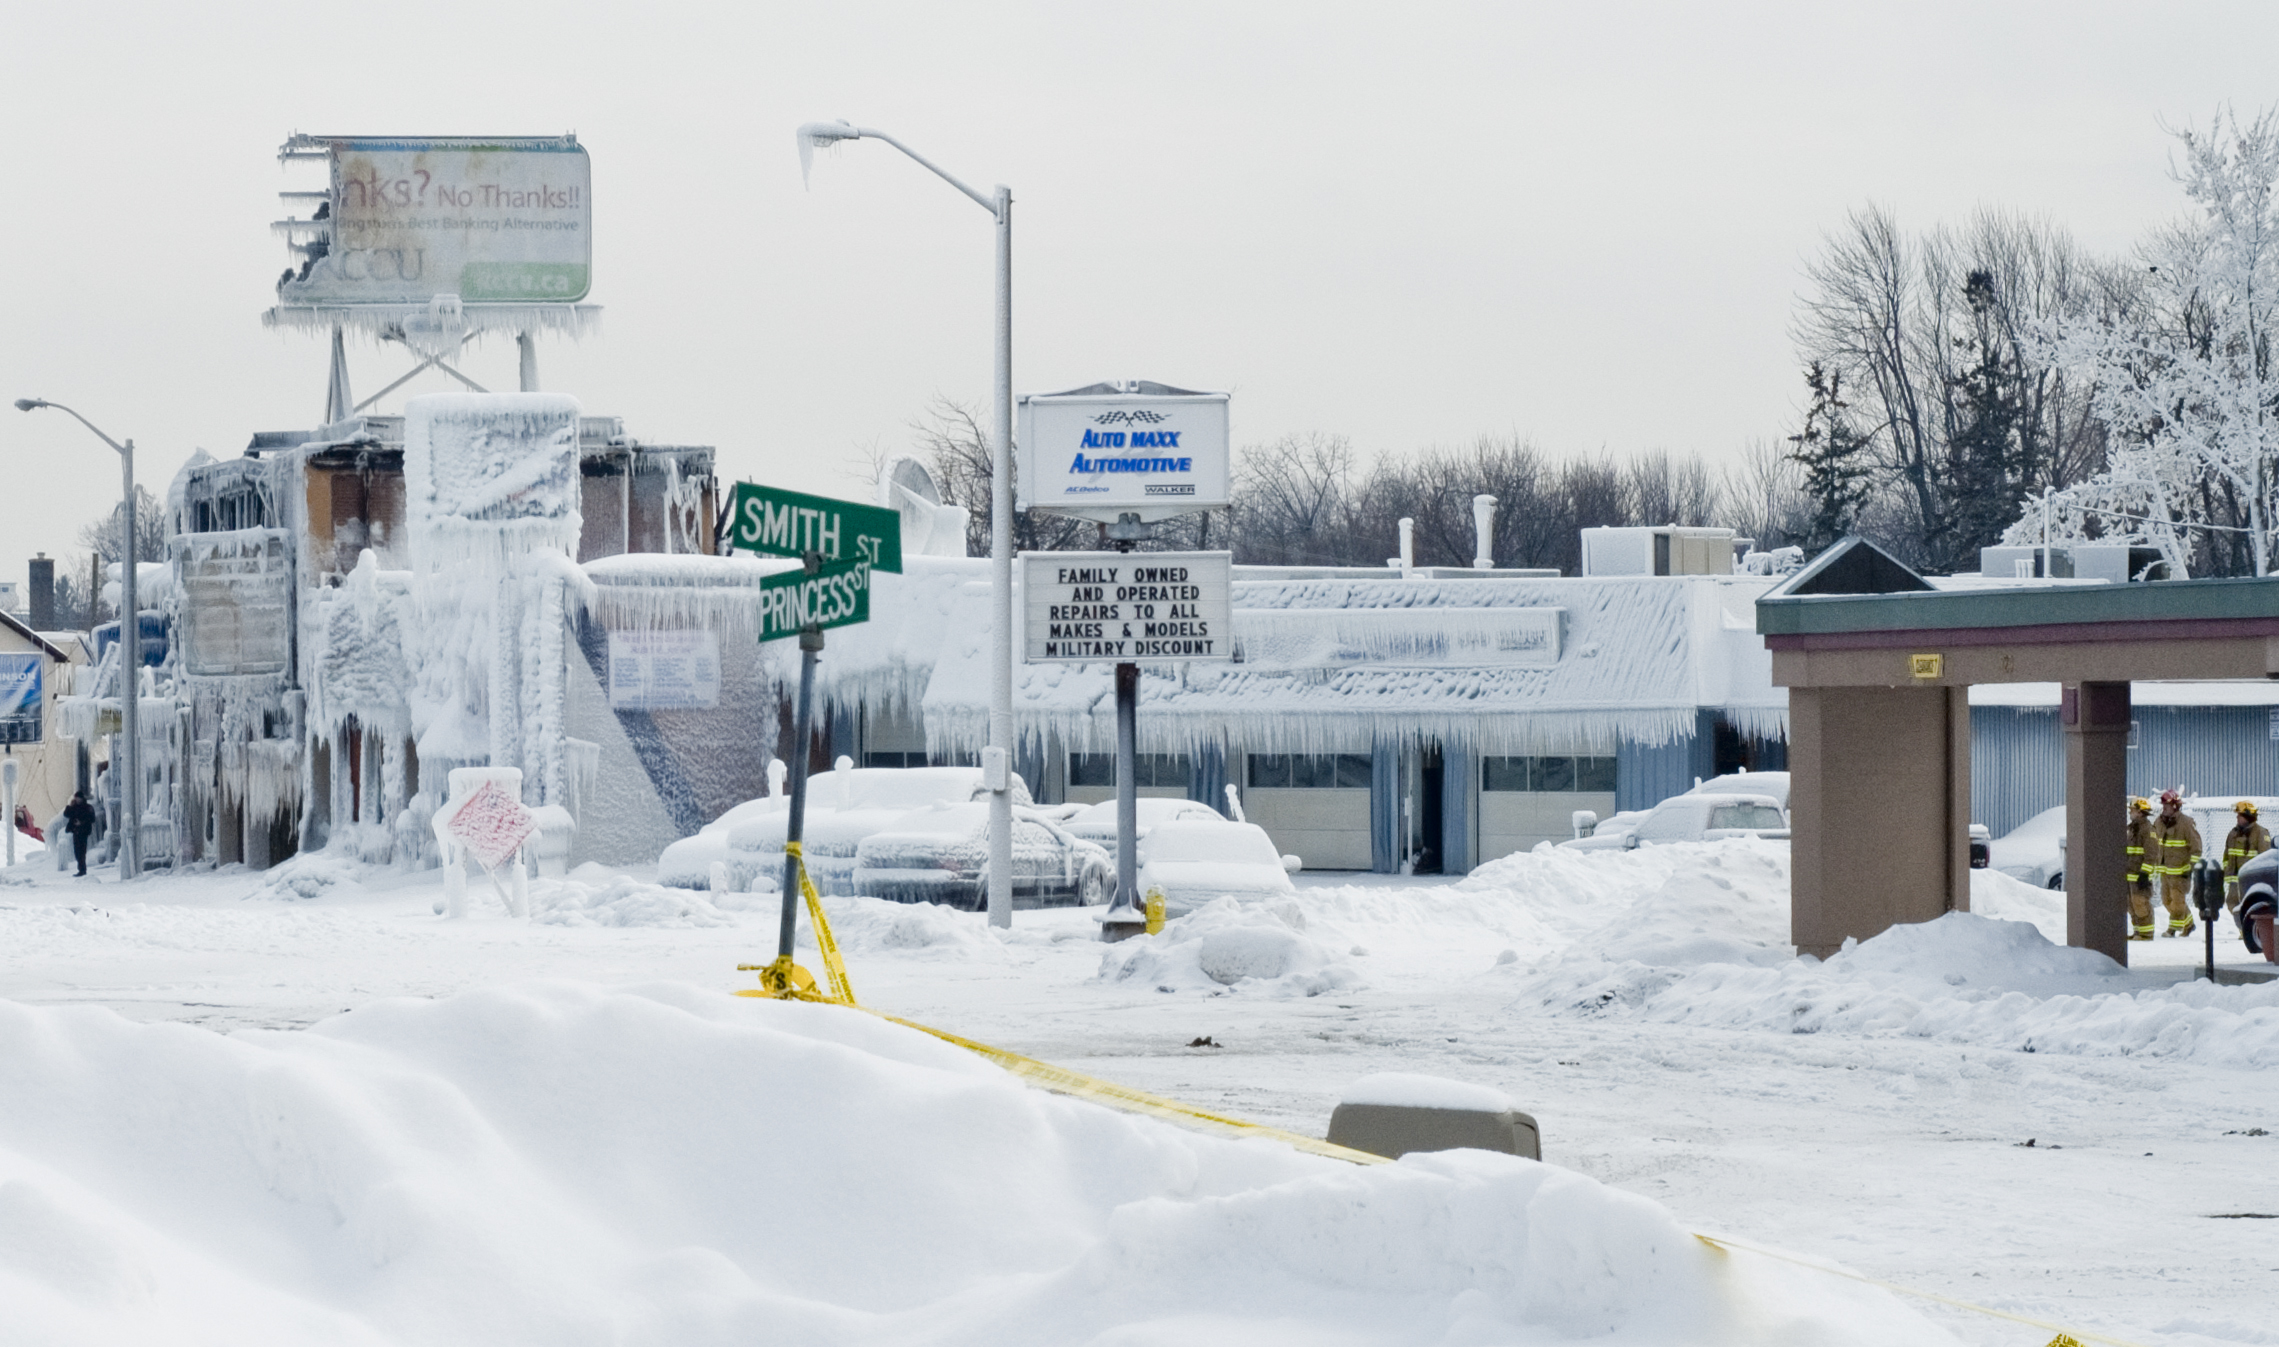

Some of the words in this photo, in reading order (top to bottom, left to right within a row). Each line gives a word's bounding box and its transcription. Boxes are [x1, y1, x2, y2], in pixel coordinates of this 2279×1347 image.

[438, 185, 473, 208] No
[479, 184, 579, 209] Thanks!!
[443, 217, 499, 232] Banking
[503, 217, 579, 231] Alternative
[1130, 430, 1182, 449] MAXX
[1145, 485, 1195, 494] WALKER
[740, 496, 841, 560] SMITH
[855, 533, 882, 564] ST
[1058, 568, 1118, 583] FAMILY
[1134, 567, 1188, 582] OWNED
[759, 570, 857, 634] PRINCESS
[854, 562, 870, 591] ST
[1072, 587, 1104, 601] AND
[1116, 586, 1200, 600] OPERATED
[1050, 605, 1119, 620] REPAIRS
[1134, 605, 1155, 619] TO
[1169, 604, 1199, 618] ALL
[1050, 623, 1102, 638] MAKES
[1122, 623, 1132, 638] &
[1144, 622, 1208, 637] MODELS
[1045, 641, 1125, 656] MILITARY
[1135, 640, 1214, 655] DISCOUNT
